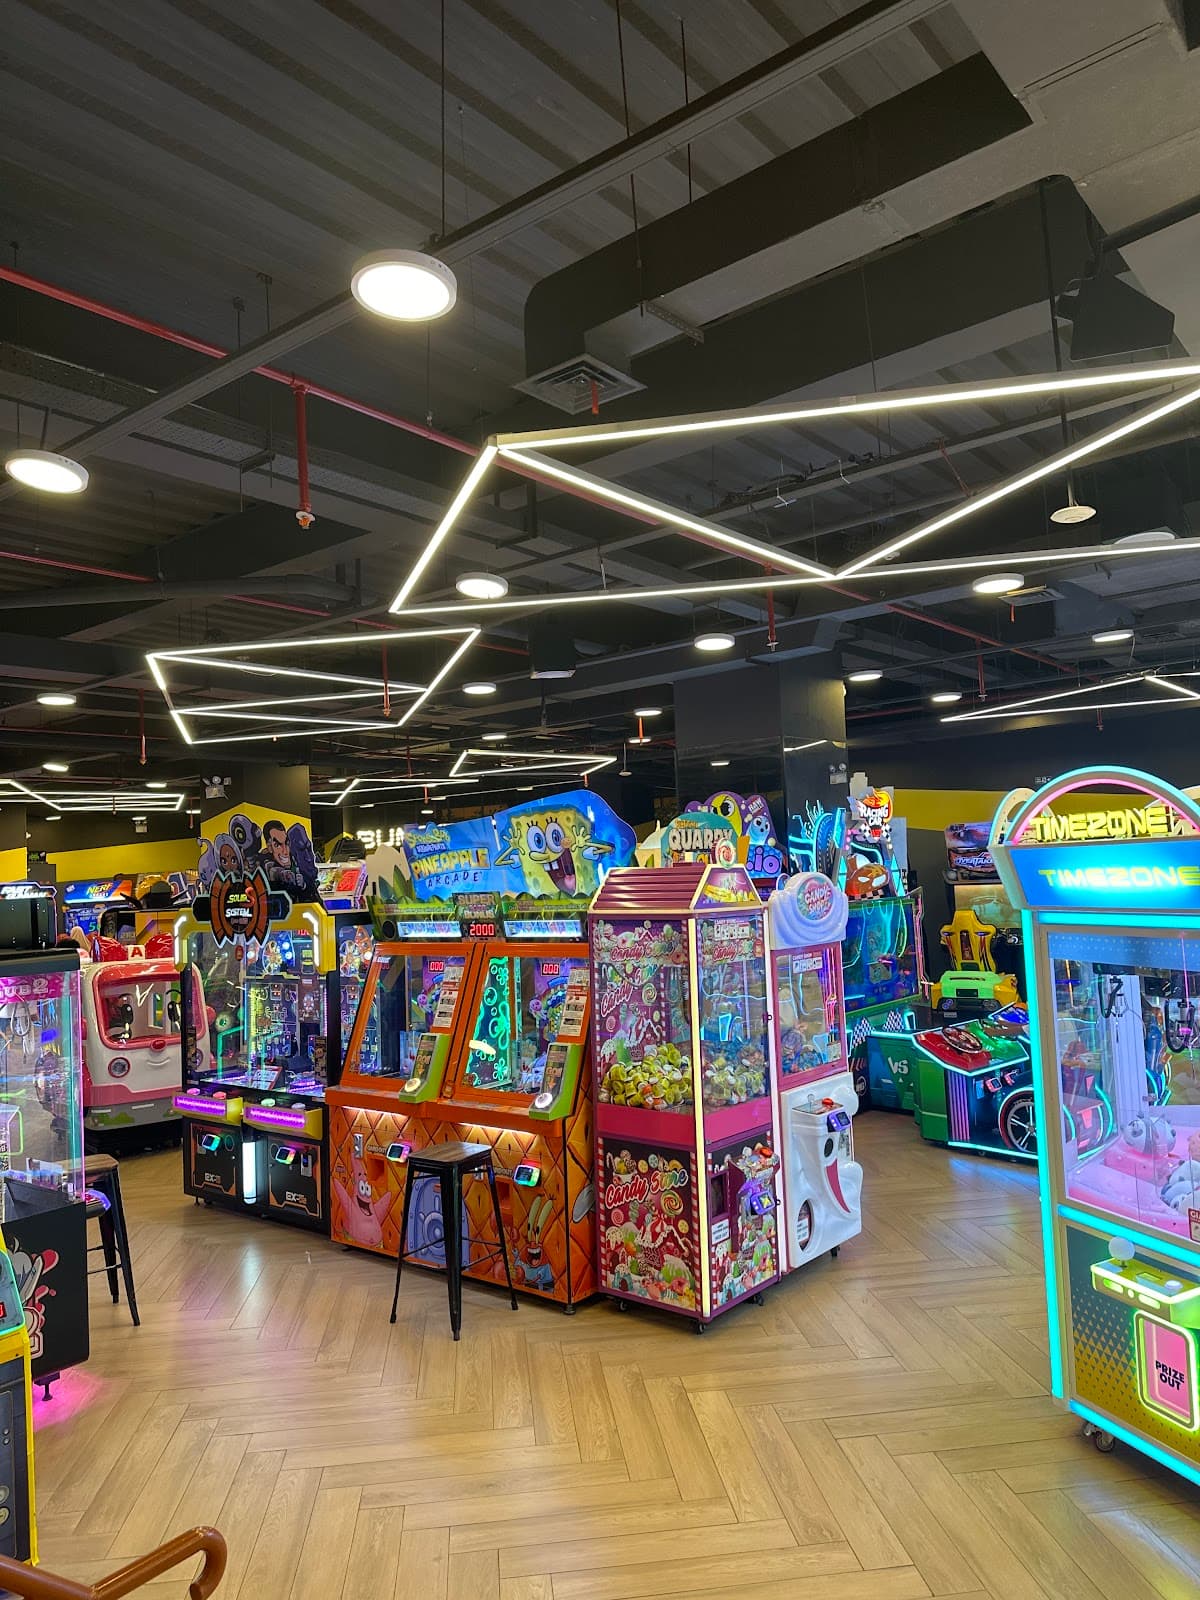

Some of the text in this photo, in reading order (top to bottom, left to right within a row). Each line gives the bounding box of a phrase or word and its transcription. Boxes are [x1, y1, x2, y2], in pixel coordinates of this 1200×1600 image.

[860, 803, 889, 818] RACING
[869, 816, 883, 827] CAR
[1029, 805, 1169, 842] TIMEZONE
[411, 848, 489, 880] PINEAPPLE
[427, 871, 481, 888] ARCADE
[1038, 865, 1200, 888] TIMEZONE
[87, 883, 113, 896] NERF
[457, 893, 495, 906] SUPER
[463, 910, 495, 920] BONUS
[469, 923, 495, 937] 2000
[130, 947, 143, 958] A
[887, 1056, 909, 1075] VS
[605, 1169, 689, 1209] Candy Store
[1155, 1359, 1186, 1384] PRIZE
[1159, 1372, 1182, 1391] OUT
